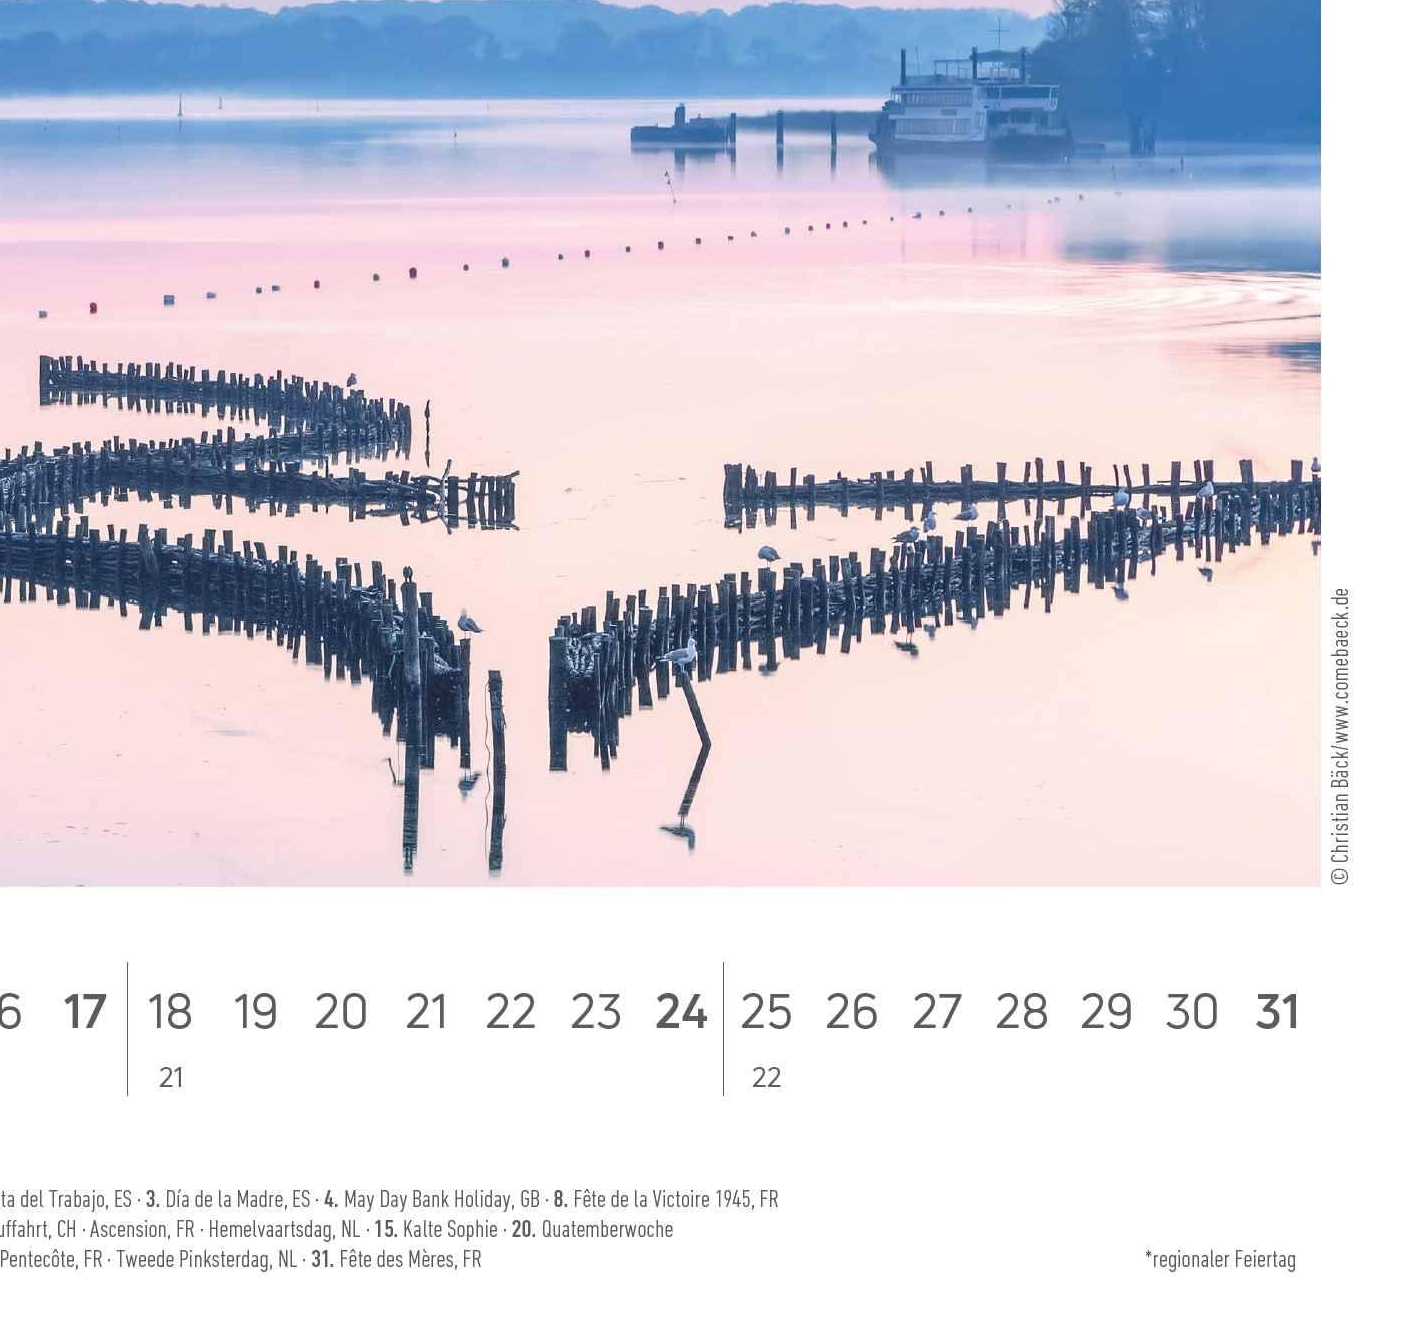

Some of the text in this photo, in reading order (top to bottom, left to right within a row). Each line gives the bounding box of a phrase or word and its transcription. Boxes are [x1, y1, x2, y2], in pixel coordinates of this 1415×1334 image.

[1329, 588, 1349, 788] Bäck/www.comebaeck.de
[1330, 793, 1349, 863] Christian
[64, 993, 107, 1029] 17
[148, 992, 192, 1030] 18
[234, 992, 277, 1030] 19
[315, 992, 367, 1030] 20
[406, 992, 445, 1029] 21
[486, 992, 536, 1029] 22
[571, 992, 621, 1030] 23
[656, 992, 708, 1029] 24
[741, 992, 792, 1030] 25
[826, 992, 878, 1030] 26
[913, 992, 963, 1029] 27
[996, 992, 1048, 1030] 28
[1081, 992, 1132, 1030] 29
[1166, 992, 1218, 1030] 30
[1255, 993, 1297, 1030] 31
[159, 1066, 182, 1088] 21
[752, 1066, 782, 1088] 22
[20, 1189, 44, 1208] del
[48, 1189, 109, 1213] Trabajo,
[114, 1189, 132, 1208] ES
[145, 1189, 160, 1208] 3.
[166, 1188, 190, 1208] Día
[194, 1189, 213, 1208] de
[218, 1189, 232, 1208] la
[237, 1189, 288, 1211] Madre,
[292, 1189, 311, 1208] ES
[323, 1189, 339, 1208] 4.
[344, 1189, 375, 1213] May
[380, 1189, 408, 1213] Day
[412, 1189, 450, 1208] Bank
[454, 1189, 515, 1213] Holiday,
[520, 1189, 540, 1208] GB
[553, 1189, 568, 1208] 8.
[574, 1188, 606, 1208] Fête
[610, 1189, 629, 1208] de
[634, 1189, 648, 1208] la
[652, 1189, 710, 1208] Victoire
[715, 1188, 755, 1211] 1945,
[760, 1189, 779, 1208] FR
[57, 1219, 76, 1238] CH
[89, 1219, 171, 1241] Ascension,
[176, 1219, 195, 1238] FR
[209, 1219, 336, 1243] Hemelvaartsdag,
[341, 1219, 361, 1238] NL
[374, 1219, 398, 1238] 15.
[403, 1219, 443, 1238] Kalte
[447, 1219, 498, 1242] Sophie
[511, 1219, 536, 1238] 20.
[542, 1219, 674, 1238] Quatemberwoche
[0, 1248, 79, 1270] Pentecôte,
[84, 1249, 103, 1268] FR
[116, 1249, 175, 1268] Tweede
[179, 1248, 273, 1273] Pinksterdag,
[278, 1249, 298, 1268] NL
[311, 1249, 334, 1268] 31.
[340, 1248, 372, 1268] Fête
[376, 1249, 404, 1268] des
[408, 1248, 458, 1270] Mères,
[463, 1249, 482, 1268] FR
[1235, 1249, 1296, 1273] Feiertag
